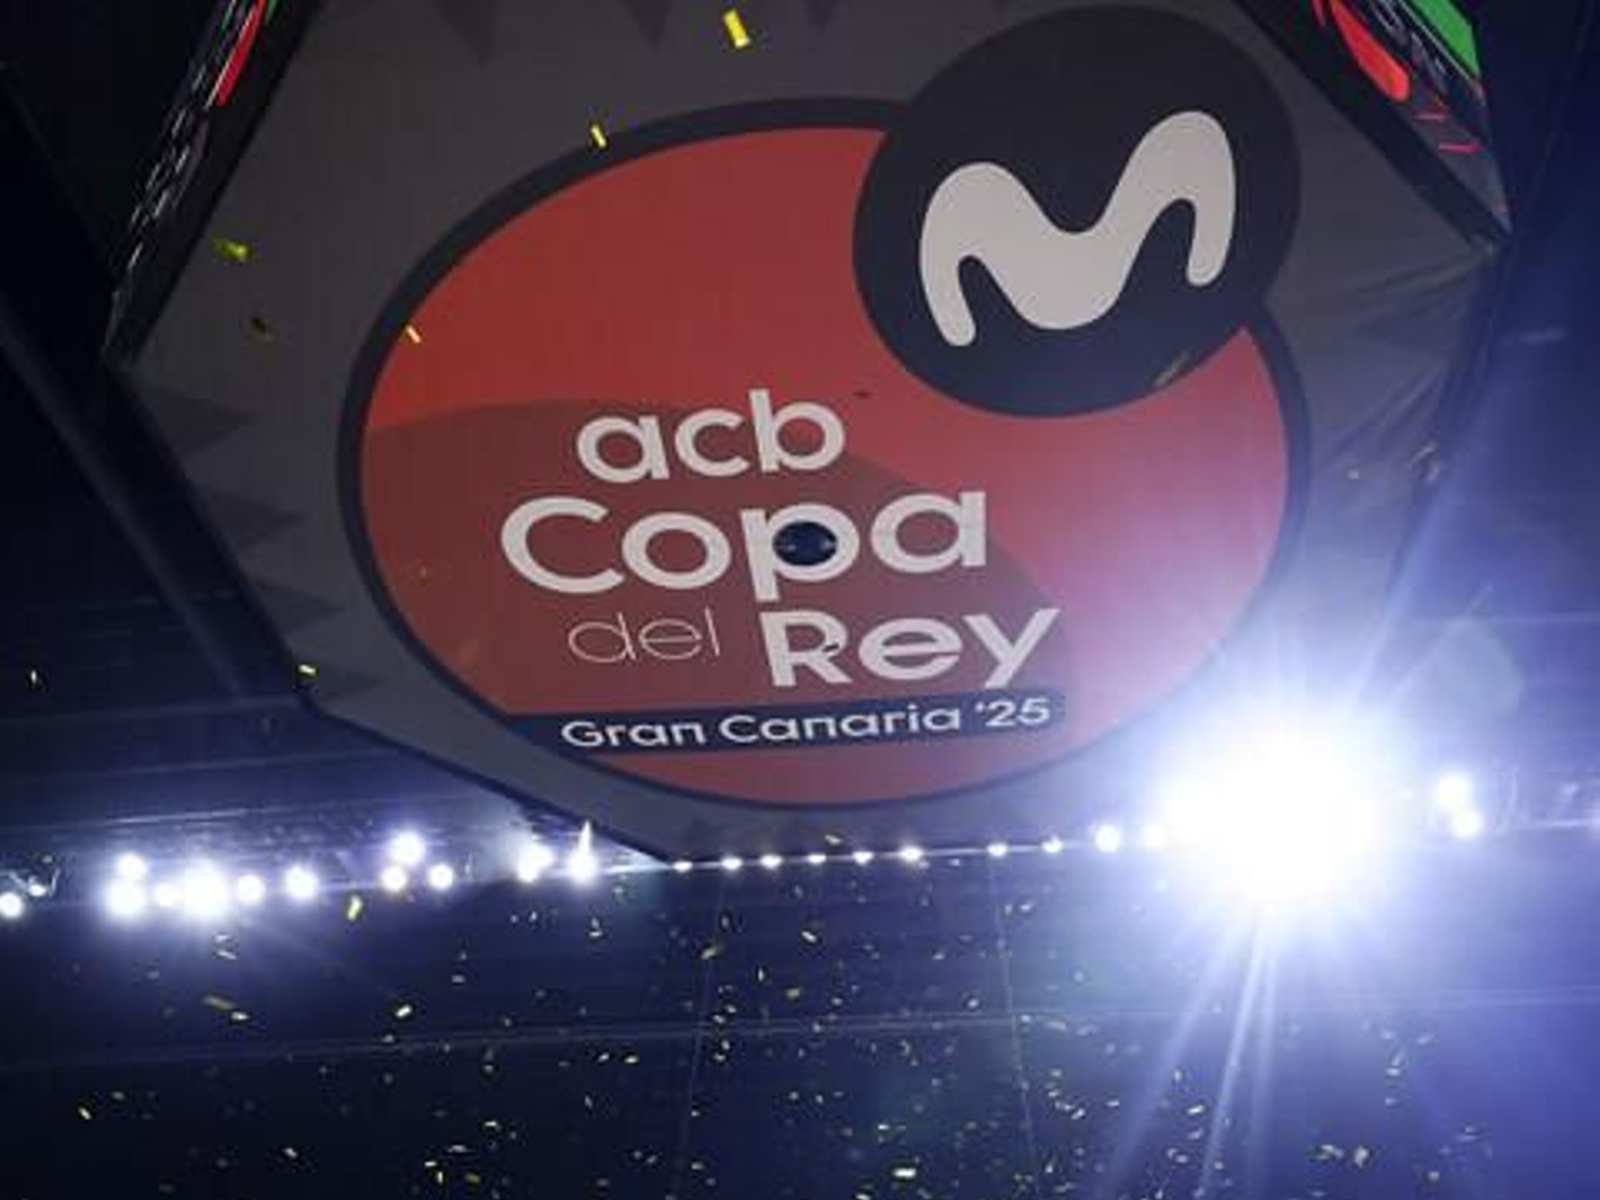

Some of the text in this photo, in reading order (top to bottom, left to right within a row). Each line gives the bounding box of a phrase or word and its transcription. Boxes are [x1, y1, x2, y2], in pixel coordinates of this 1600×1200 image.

[575, 388, 845, 483] acb
[500, 490, 987, 601] Copa
[567, 607, 1060, 687] del Rey
[561, 721, 706, 750] Gran
[719, 704, 961, 743] Canaria
